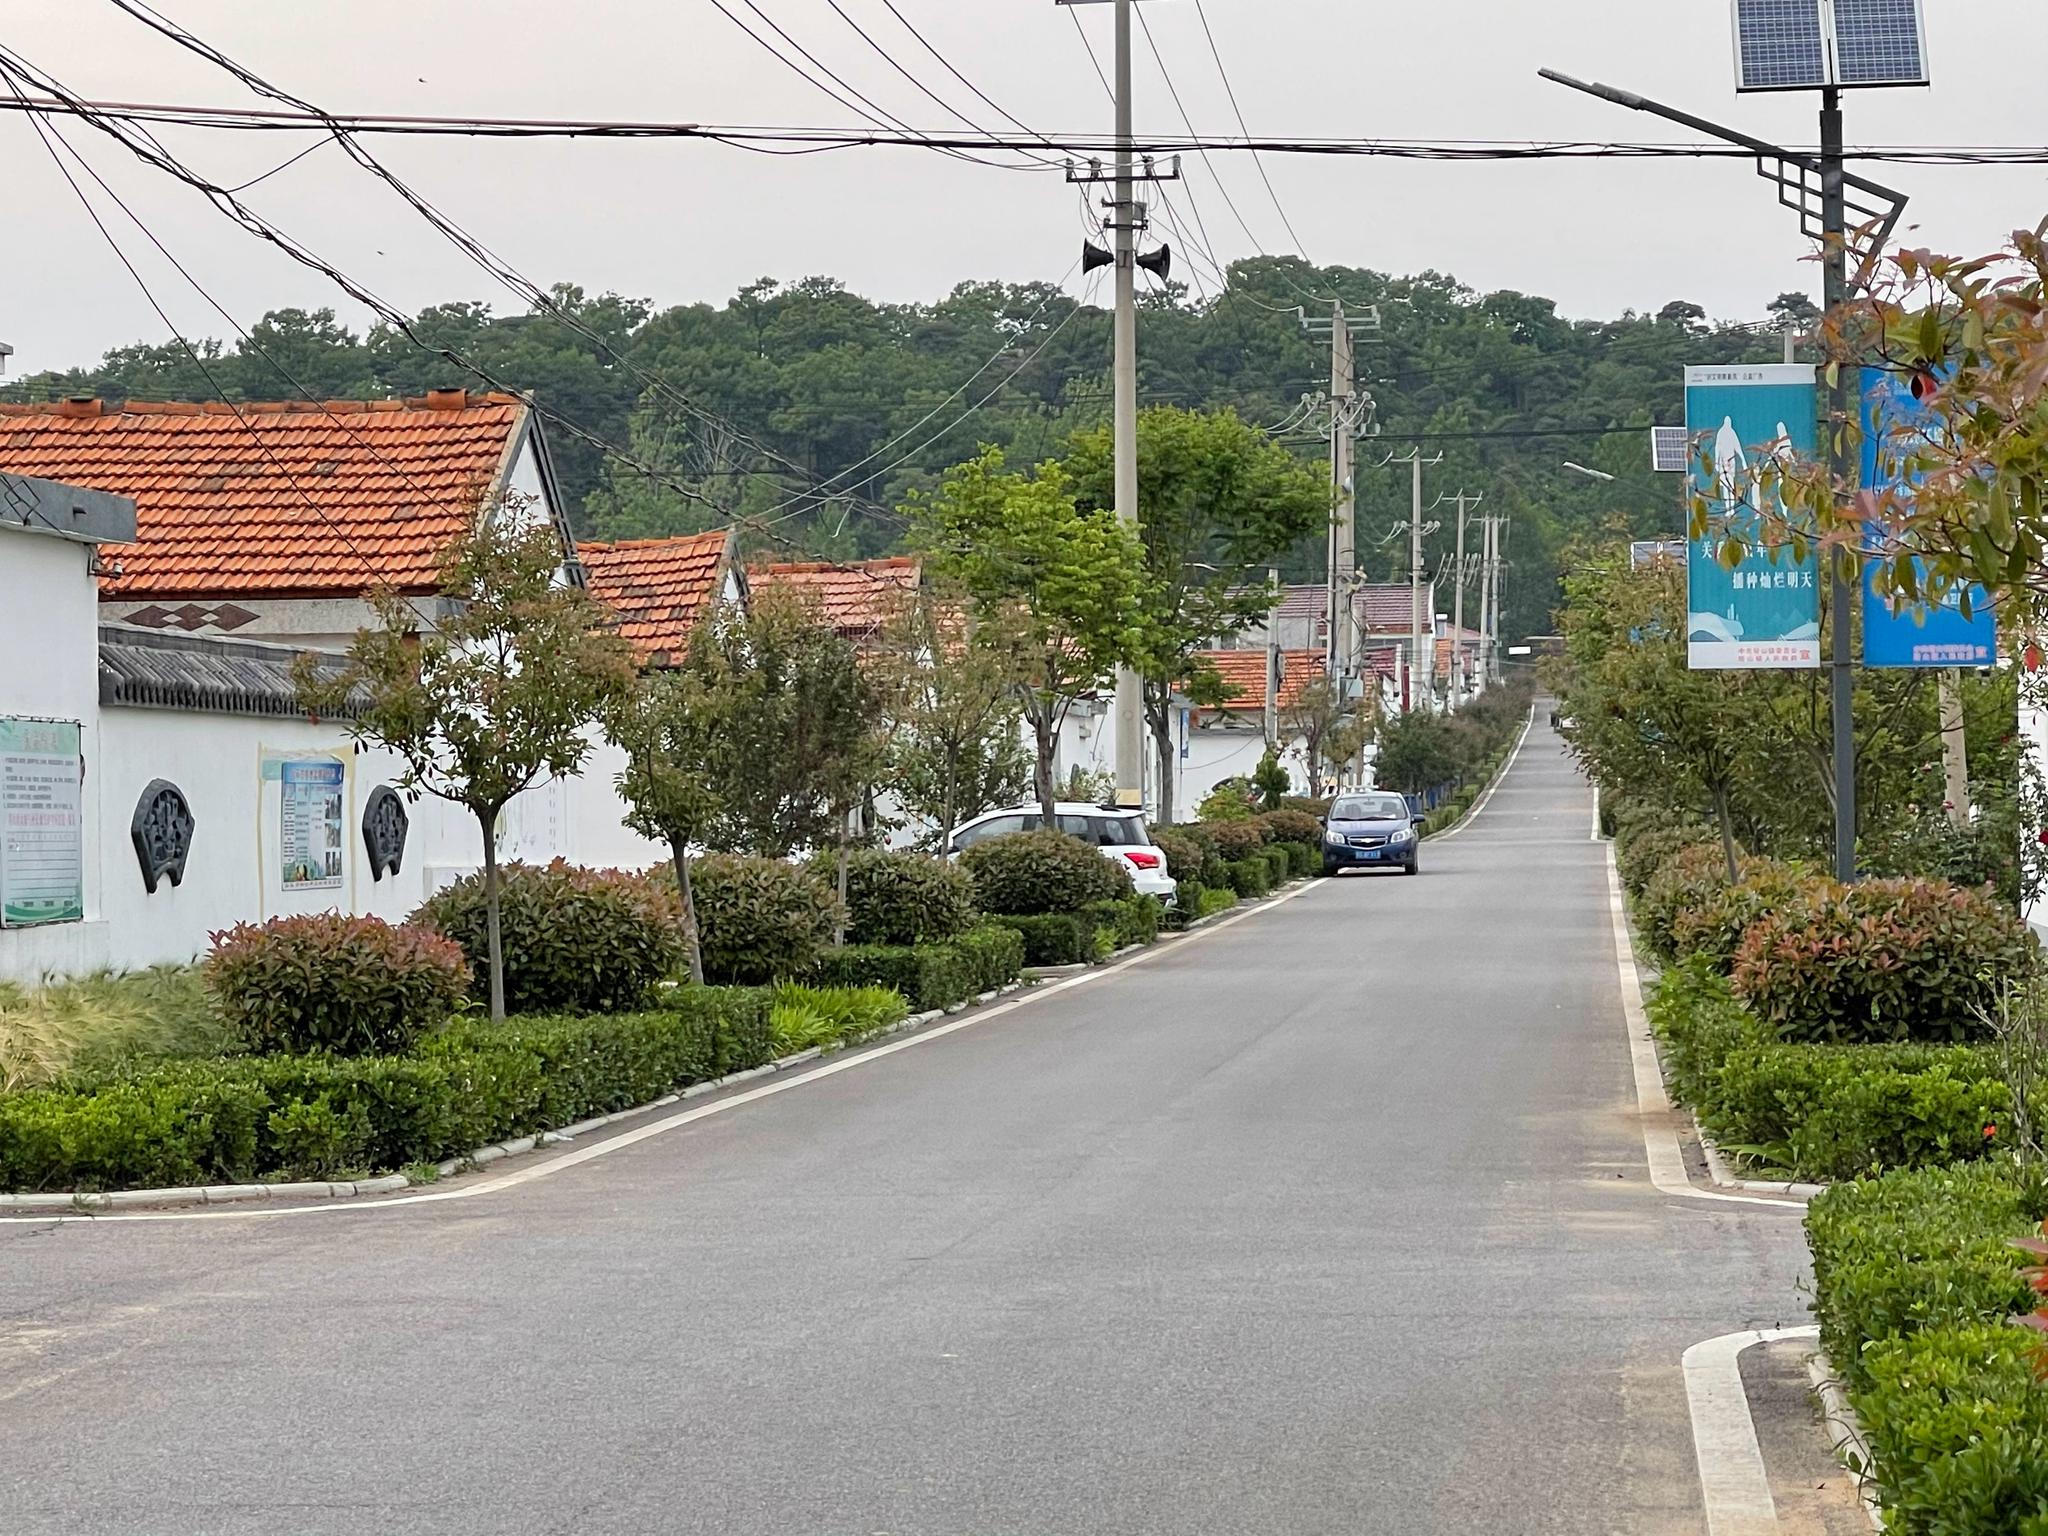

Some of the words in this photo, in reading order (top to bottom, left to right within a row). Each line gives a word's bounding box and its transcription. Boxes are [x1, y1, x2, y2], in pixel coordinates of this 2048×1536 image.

[1733, 572, 1812, 589] 播种灿烂明天
